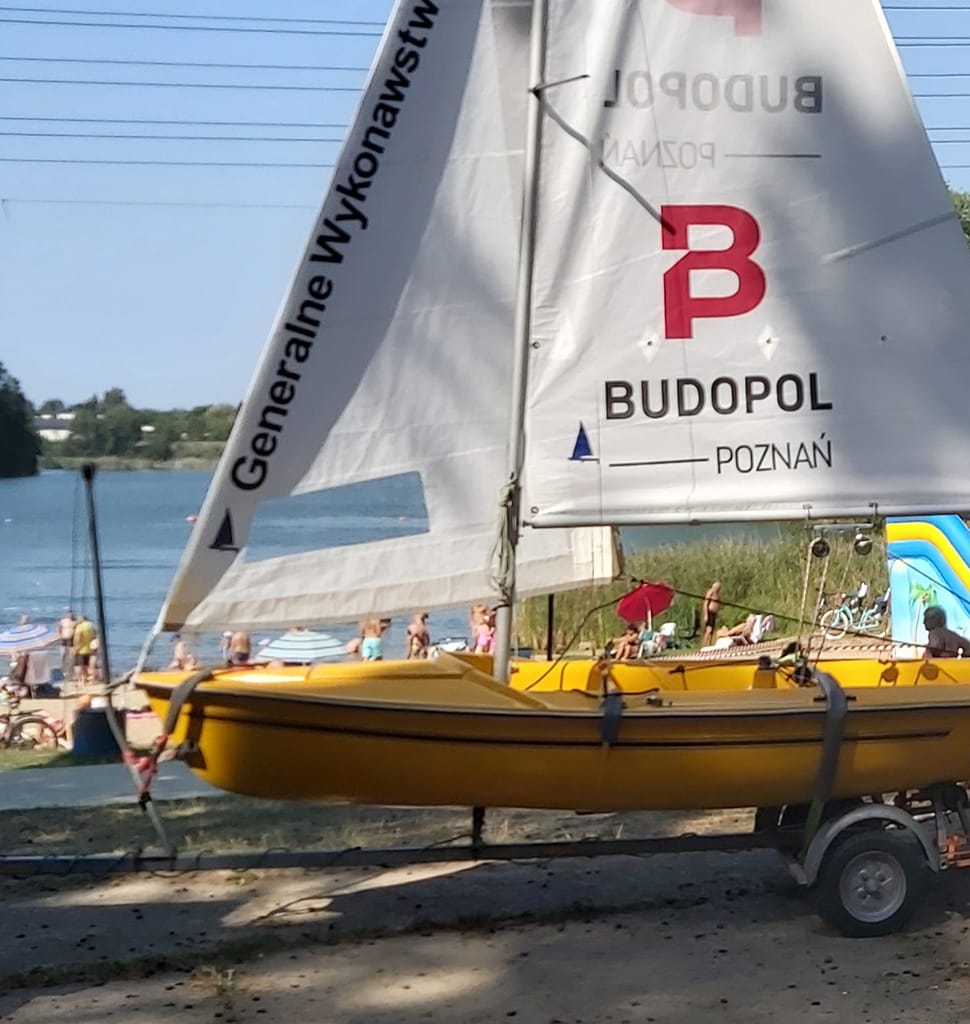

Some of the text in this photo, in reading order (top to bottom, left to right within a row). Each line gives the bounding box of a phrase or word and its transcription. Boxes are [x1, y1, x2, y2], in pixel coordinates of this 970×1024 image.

[230, 274, 334, 492] Generalne
[604, 372, 833, 420] BUDOPOL
[716, 432, 833, 474] POZNAŃ
